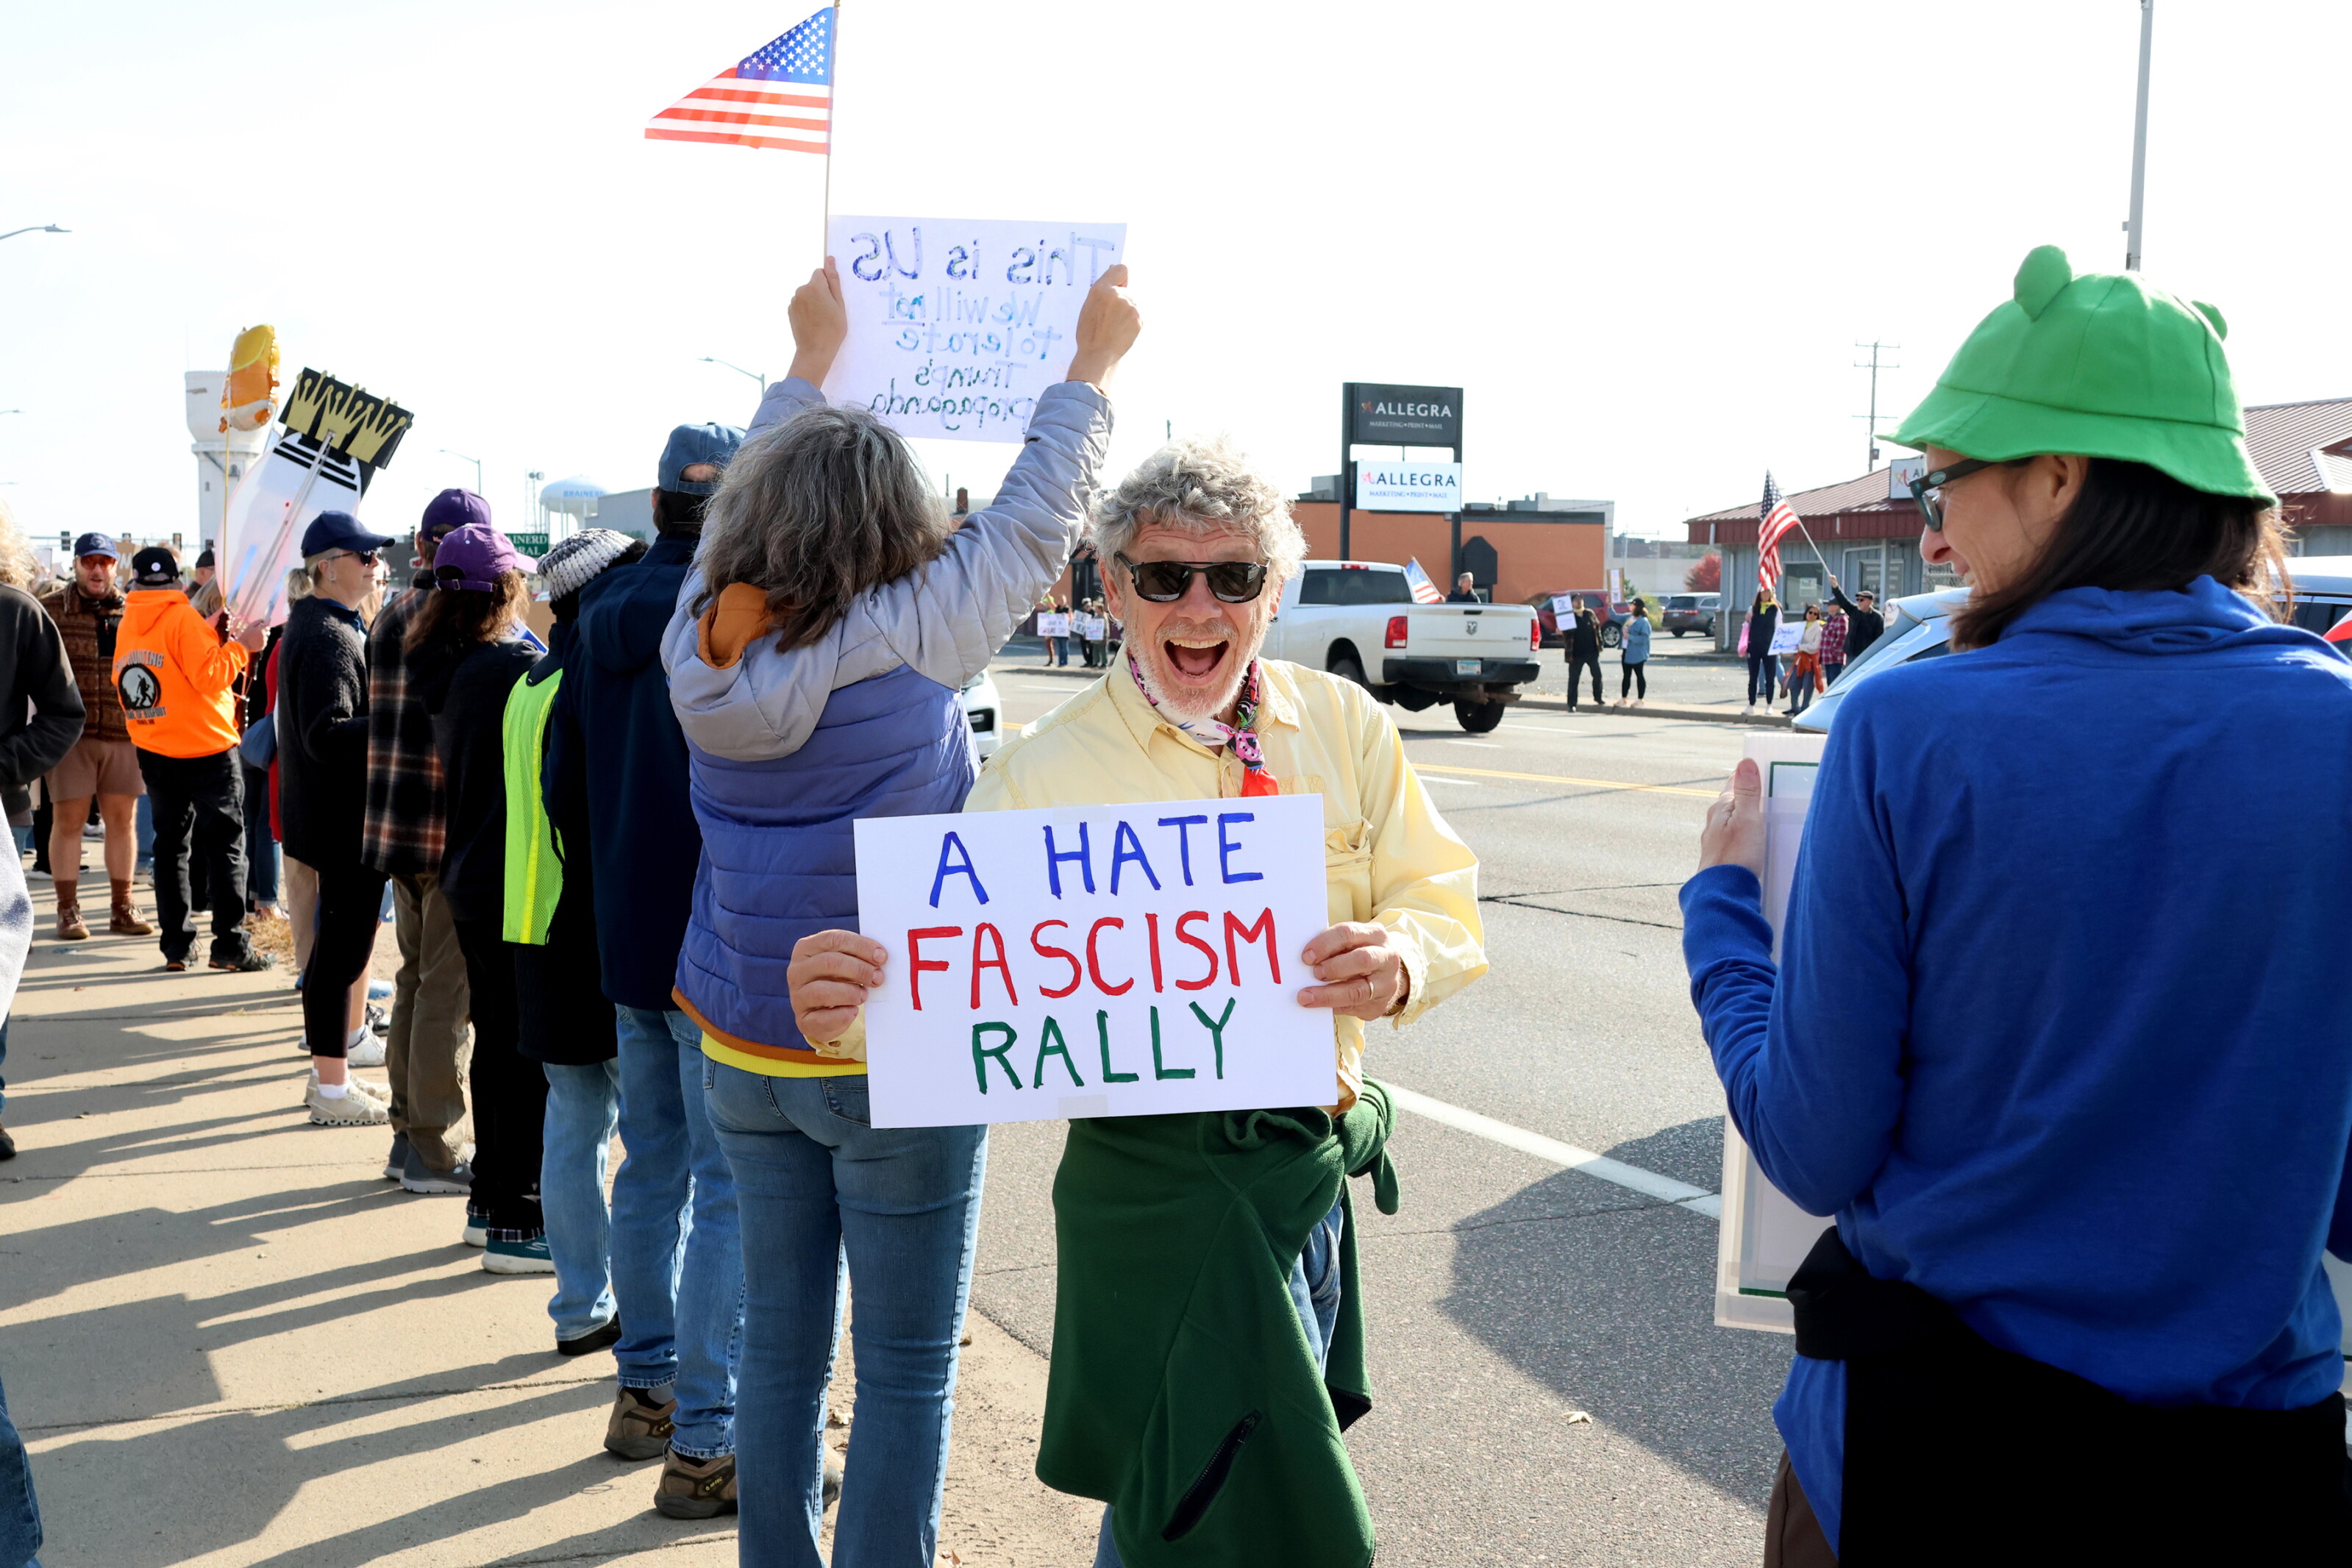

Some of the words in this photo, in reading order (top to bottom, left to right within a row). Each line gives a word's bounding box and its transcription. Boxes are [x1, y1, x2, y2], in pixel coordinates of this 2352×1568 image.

[1375, 402, 1453, 418] ALLEGRA
[1376, 472, 1457, 487] ALLEGRA
[510, 535, 547, 544] INERD
[929, 830, 990, 908] A
[1042, 812, 1264, 899] HATE
[907, 907, 1282, 1011] FASCISM
[971, 997, 1237, 1094] RALLY
